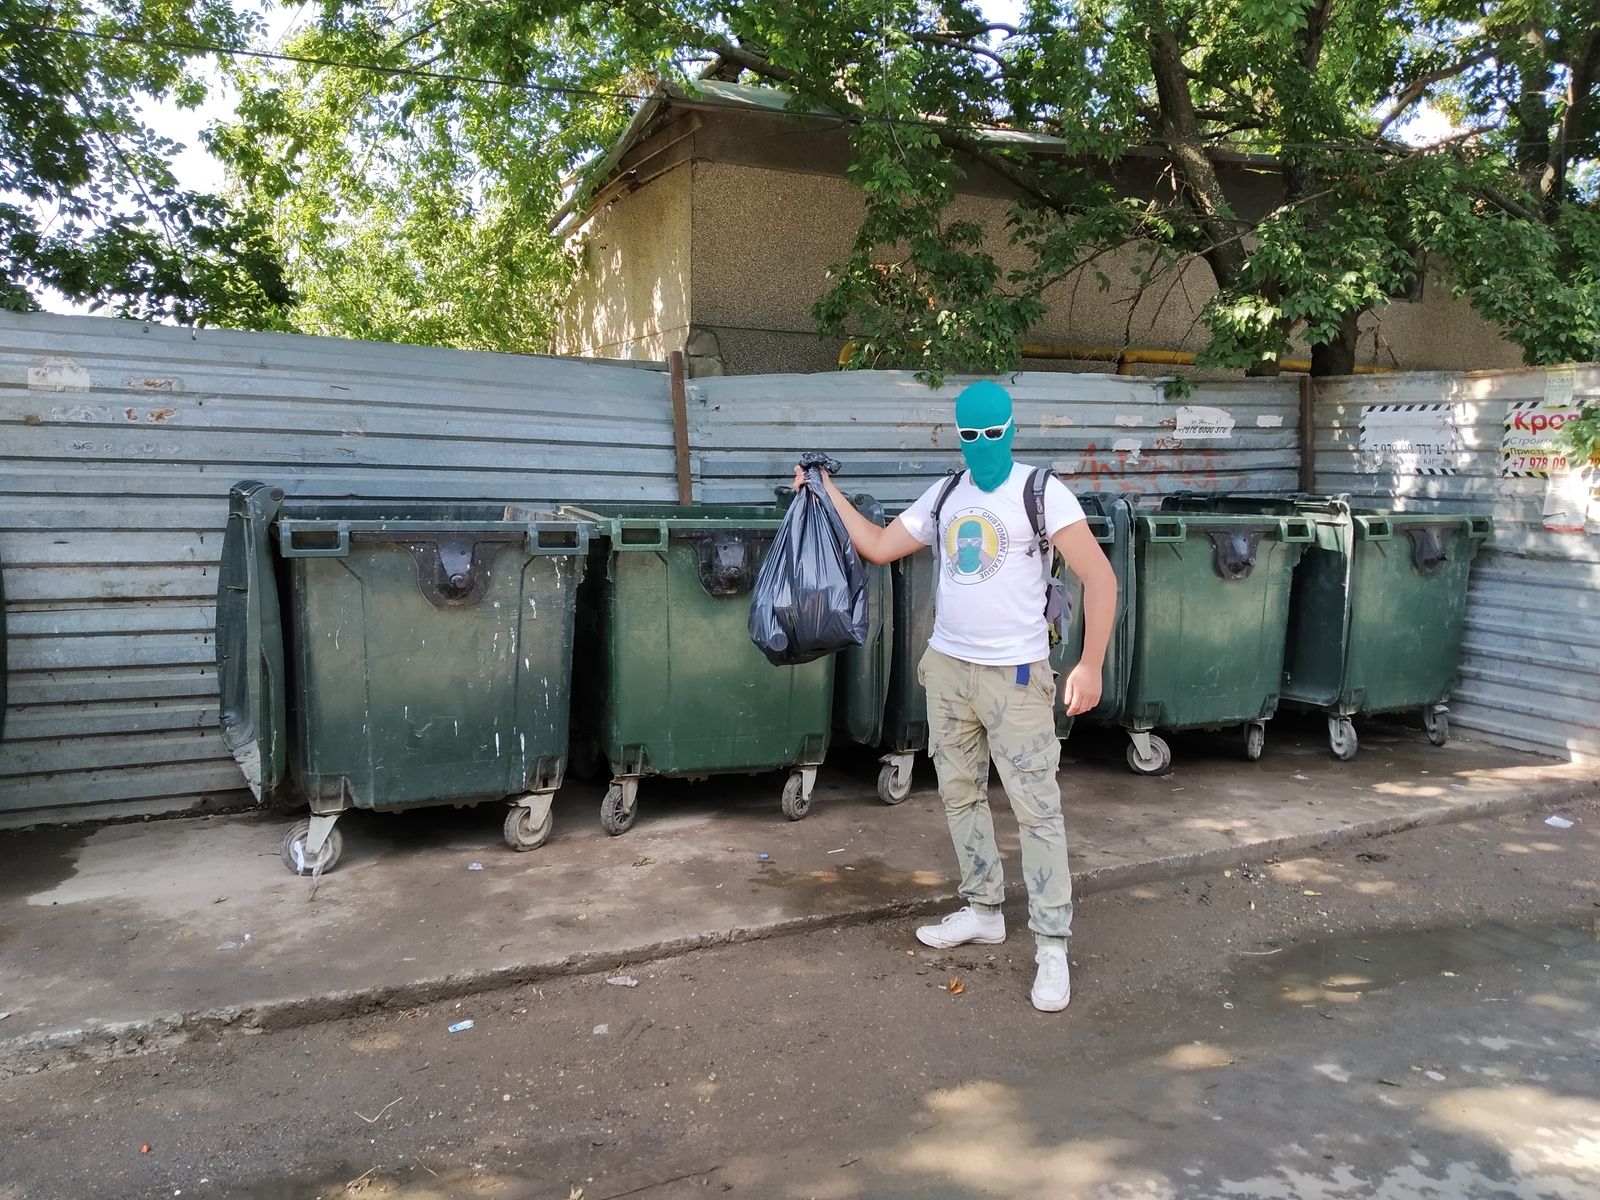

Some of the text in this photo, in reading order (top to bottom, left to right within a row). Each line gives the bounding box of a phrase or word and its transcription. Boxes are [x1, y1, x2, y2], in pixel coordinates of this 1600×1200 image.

[1512, 457, 1526, 470] +7
[1529, 457, 1548, 470] 978
[1552, 457, 1567, 470] 09
[979, 511, 1007, 580] CHISTOMAN LEAGUE
